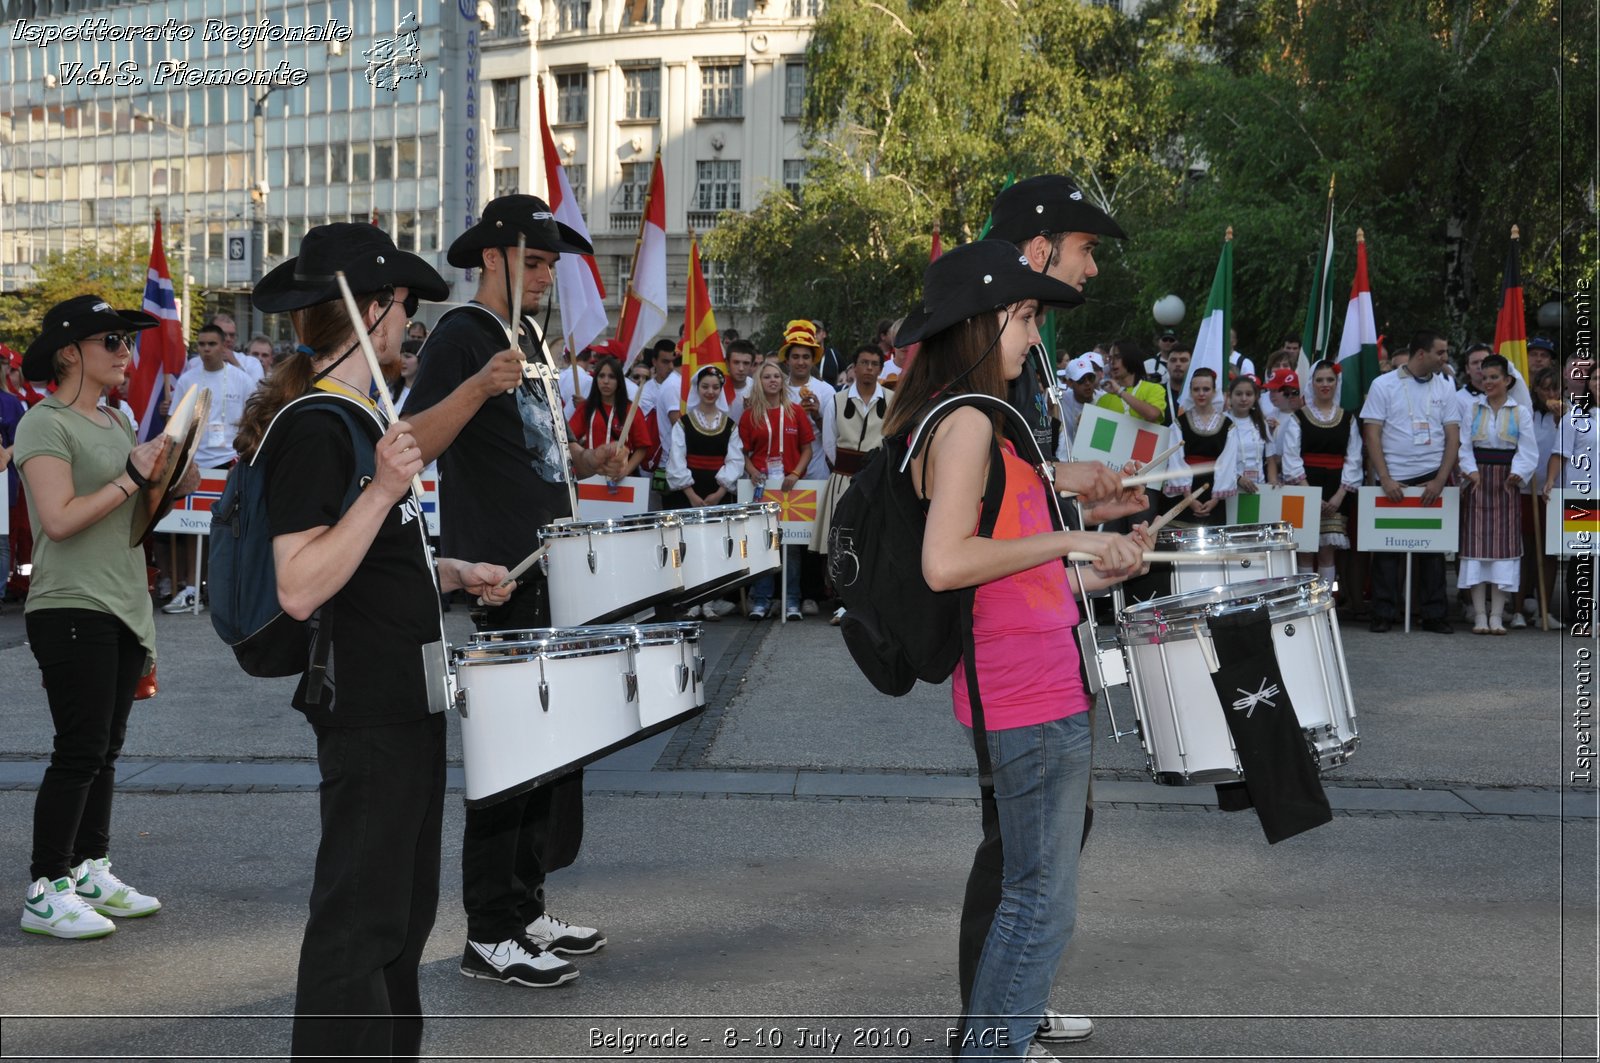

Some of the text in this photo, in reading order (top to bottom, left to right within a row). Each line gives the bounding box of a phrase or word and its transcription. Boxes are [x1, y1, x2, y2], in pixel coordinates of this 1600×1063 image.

[180, 518, 210, 528] Norw
[782, 528, 812, 541] donia
[1385, 536, 1432, 549] Hungary
